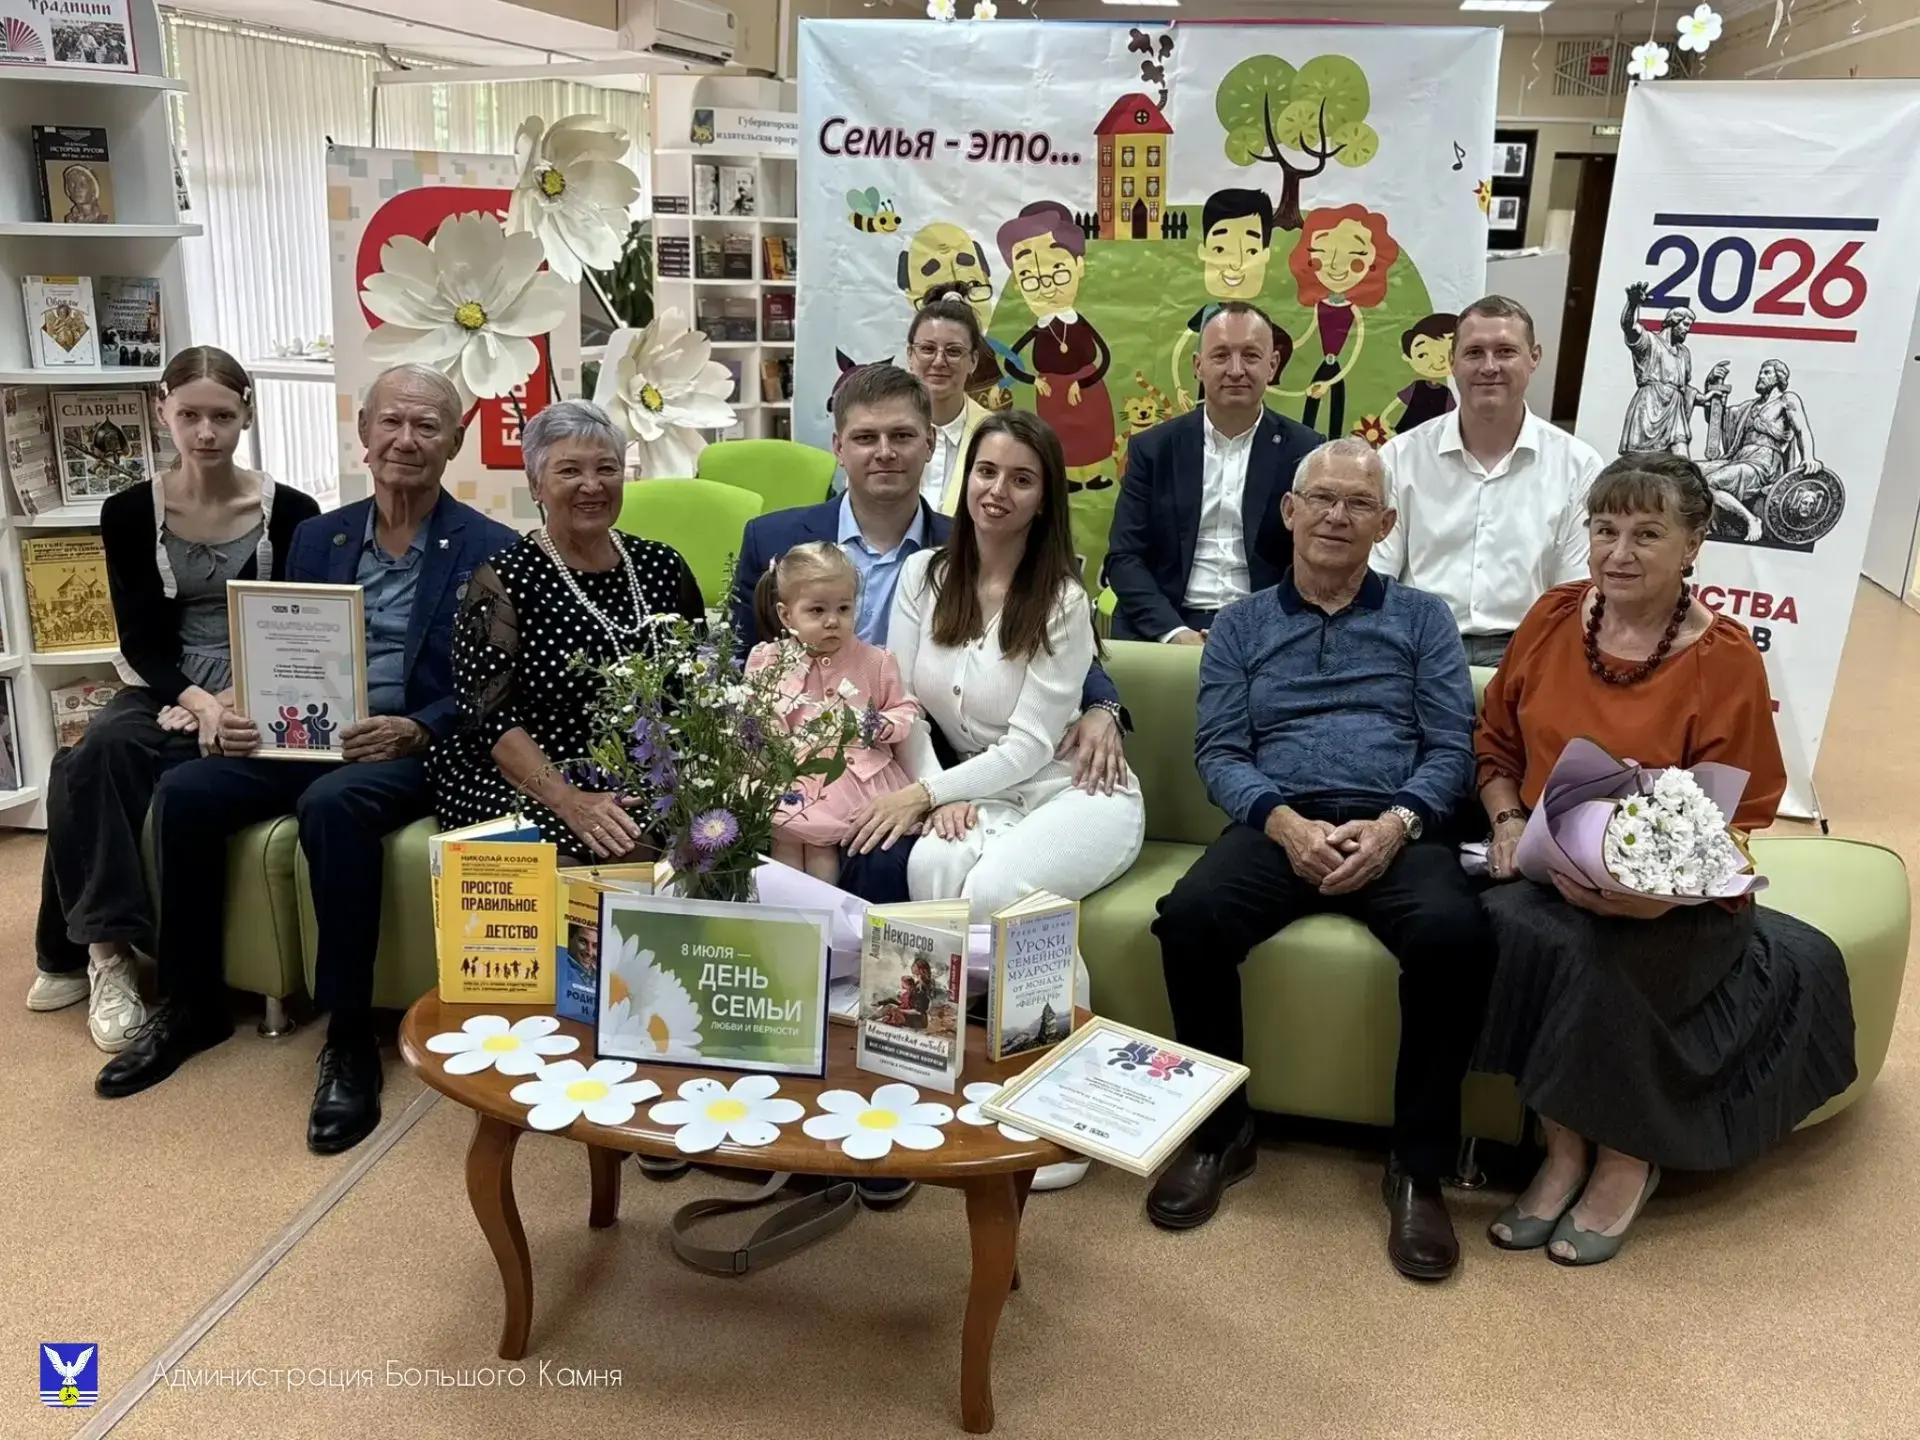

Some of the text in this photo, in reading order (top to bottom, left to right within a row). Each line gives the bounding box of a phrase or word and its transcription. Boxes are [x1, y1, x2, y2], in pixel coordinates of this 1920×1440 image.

[819, 117, 936, 159] Семья
[967, 131, 1081, 163] это...
[1643, 234, 1868, 319] 2026
[62, 403, 138, 417] СЛАВЯНЕ
[461, 880, 513, 895] ПРОСТОЕ
[461, 897, 538, 912] ПРАВИЛЬНОЕ
[485, 924, 538, 939] ДЕТСТВО
[883, 923, 934, 952] Некрасов
[681, 943, 689, 956] 8
[692, 945, 734, 960] ИЮЛЯ
[1016, 933, 1066, 955] УРОКИ
[1007, 944, 1072, 969] СЕМЕЙНОЙ
[698, 963, 769, 991] ДЕНЬ
[1008, 958, 1071, 982] МУДРОСТИ
[566, 989, 595, 1004] РОДИ
[711, 994, 802, 1022] СЕМЬИ
[711, 1021, 799, 1036] ЛЮБВИ И ВЕРНОСТИ
